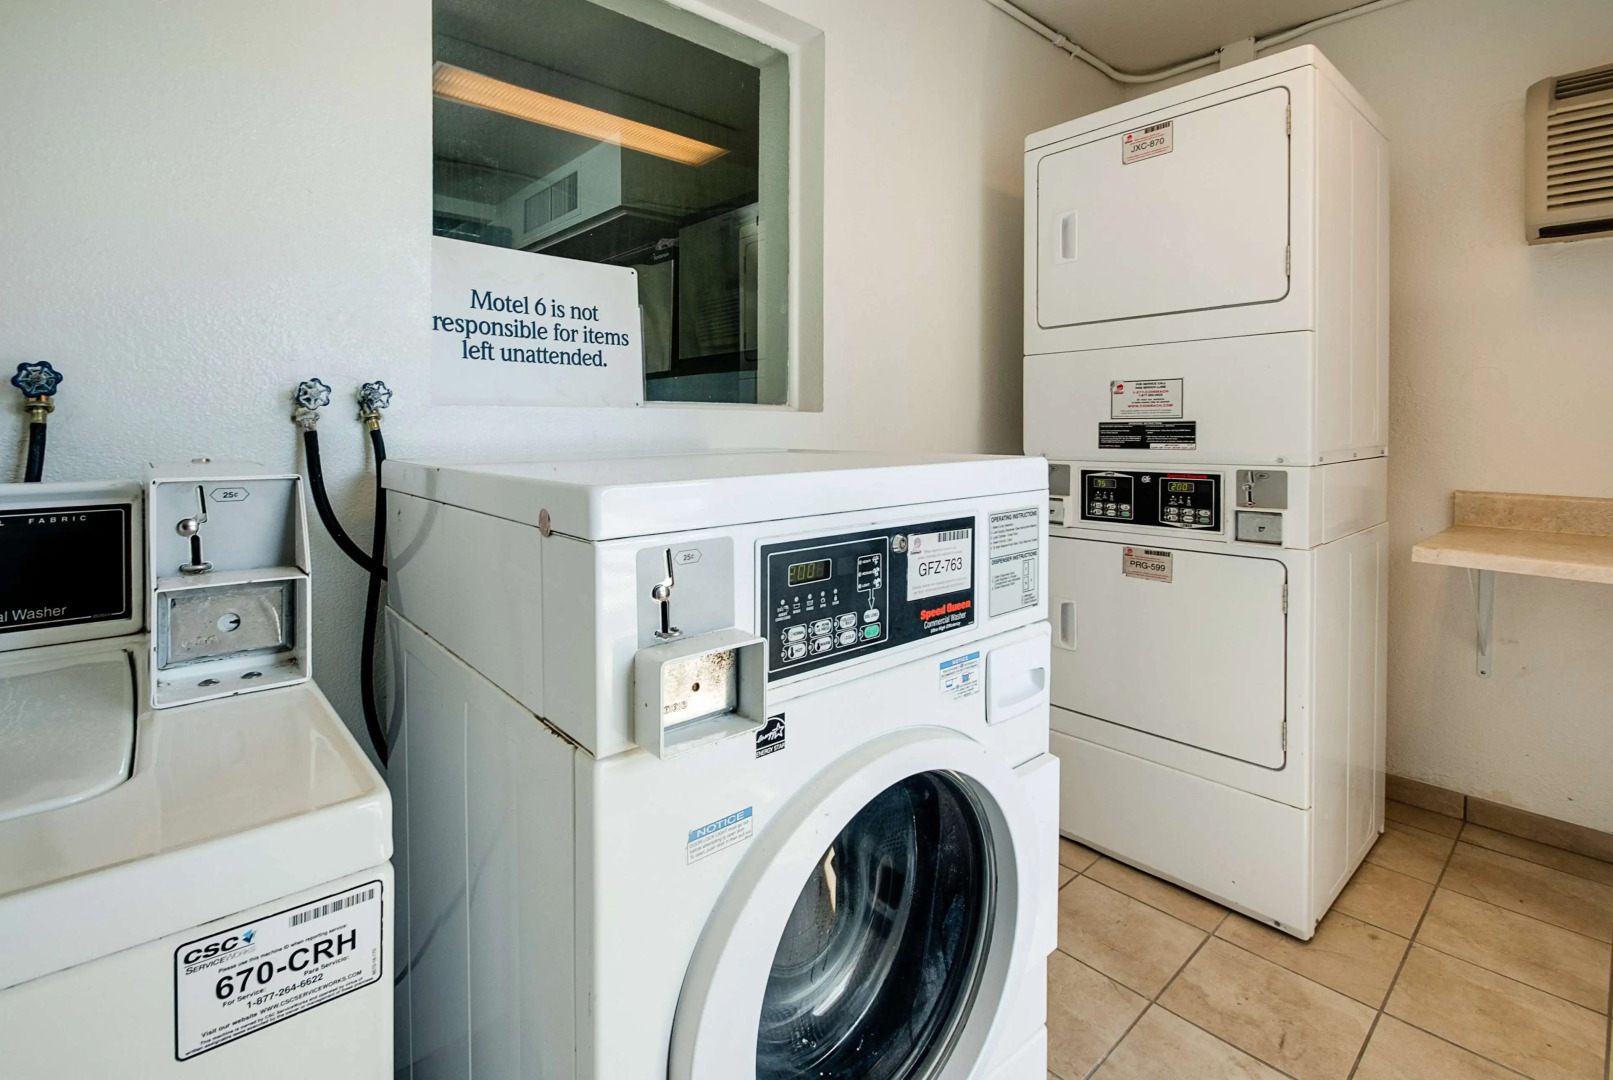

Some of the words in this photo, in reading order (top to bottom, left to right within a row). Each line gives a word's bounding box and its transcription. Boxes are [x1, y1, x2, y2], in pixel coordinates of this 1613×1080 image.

[1131, 137, 1165, 153] JXC-870
[470, 289, 530, 314] Motel
[534, 297, 546, 316] 6
[551, 299, 565, 318] is
[570, 305, 599, 322] not
[432, 315, 548, 339] responsible
[553, 323, 578, 343] for
[583, 326, 629, 346] items
[461, 340, 495, 360] left
[500, 346, 607, 367] unattended.
[1171, 483, 1188, 491] 200
[28, 515, 87, 525] FABRIC
[991, 514, 1012, 523] OPERATING
[1012, 510, 1038, 519] INSTRUCTIONS
[918, 557, 962, 577] GFZ-763
[992, 556, 1012, 566] DISPENSER
[1012, 550, 1038, 560] INSTRUCTIONS
[1130, 560, 1166, 572] PRG-599
[12, 606, 68, 620] Washer
[920, 603, 947, 621] Speed
[947, 600, 972, 612] Queen
[923, 614, 951, 630] Commercial
[951, 611, 967, 622] Washer
[756, 746, 773, 759] ENERGY
[773, 741, 786, 752] STAR
[696, 811, 745, 838] NOTICE
[183, 936, 239, 965] CSC
[218, 963, 237, 974] Please
[238, 959, 249, 967] use
[249, 955, 259, 963] this
[260, 947, 283, 958] machine
[290, 938, 304, 948] when
[305, 930, 329, 942] reporting
[215, 928, 357, 1000] 670-CRH
[304, 967, 319, 976] Para
[320, 955, 350, 970] Servicio:
[222, 999, 235, 1008] For
[237, 987, 267, 1002] Service:
[247, 972, 325, 1009] 1-877-264-6622
[201, 1028, 217, 1038] Visit
[218, 1022, 230, 1032] our
[232, 1012, 258, 1026] website
[260, 970, 363, 1014] WWW.CSCSERVICEWORKS.COM
